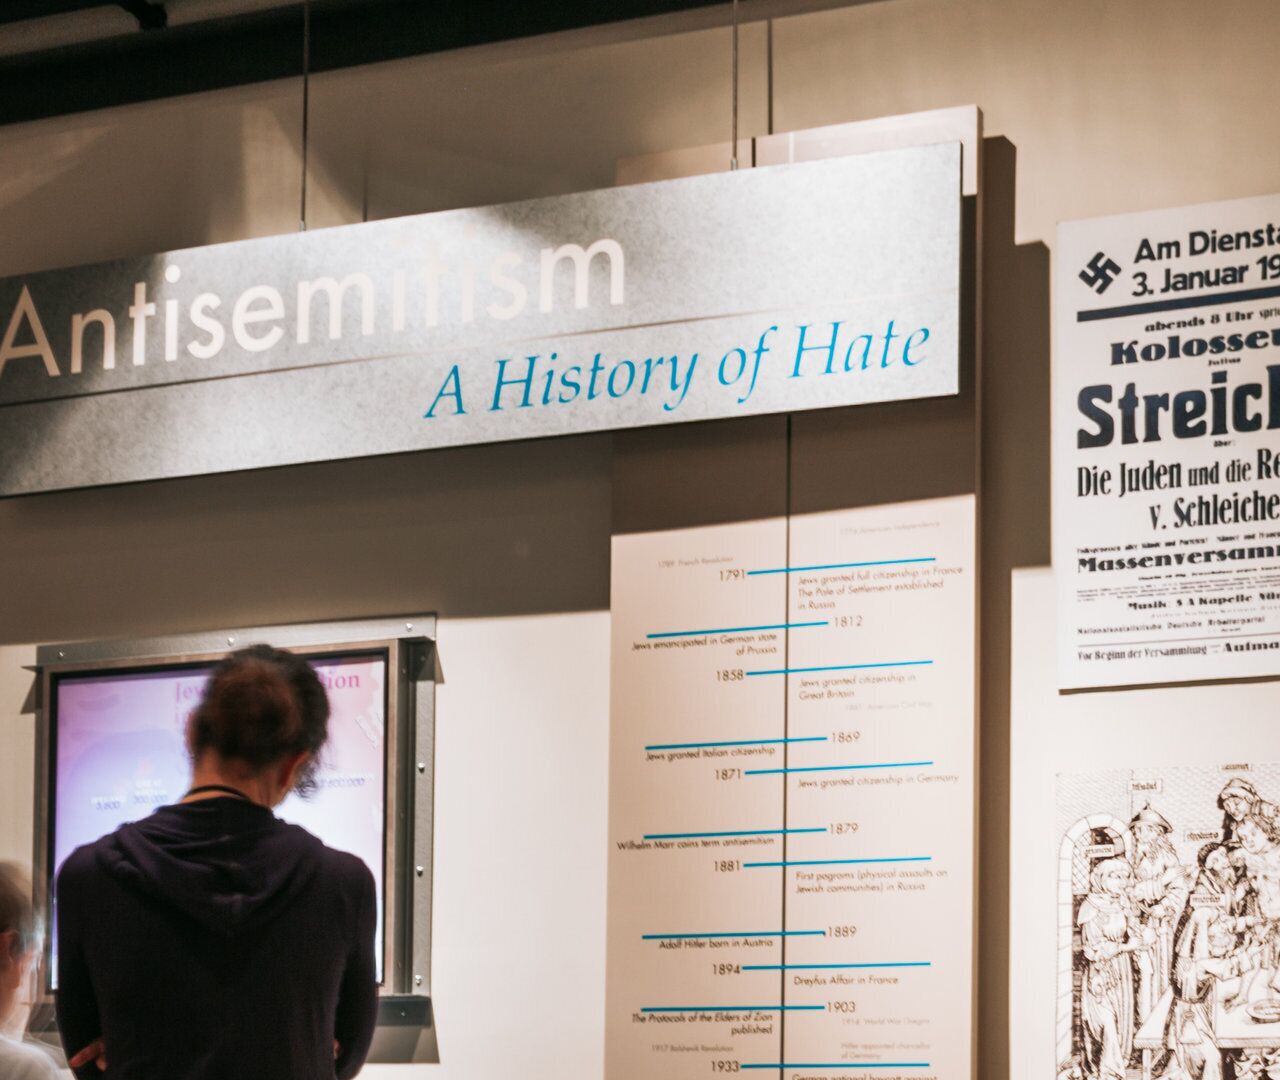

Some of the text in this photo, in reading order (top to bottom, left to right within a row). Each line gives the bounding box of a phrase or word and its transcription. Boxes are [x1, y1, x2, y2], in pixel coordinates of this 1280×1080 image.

[1132, 236, 1181, 264] Am
[1131, 275, 1154, 297] 3.
[1161, 263, 1249, 293] Januar
[1144, 316, 1206, 333] abends
[1225, 309, 1254, 324] Uhr
[422, 319, 931, 420] A History of Hate
[1077, 466, 1111, 498] Die
[1119, 459, 1182, 498] Juden
[1188, 462, 1220, 486] und
[1226, 459, 1251, 483] die
[719, 569, 746, 582] 1791
[833, 616, 863, 628] 1812
[716, 670, 744, 681] 1858
[831, 732, 860, 743] 1869
[715, 769, 742, 780] 1871
[829, 823, 859, 835] 1879
[713, 861, 741, 872] 1881
[827, 926, 857, 937] 1889
[659, 938, 773, 950] Adolf Hitler born in Austria
[712, 964, 741, 976] 1894
[825, 1002, 856, 1013] 1903
[710, 1061, 740, 1072] 1933
